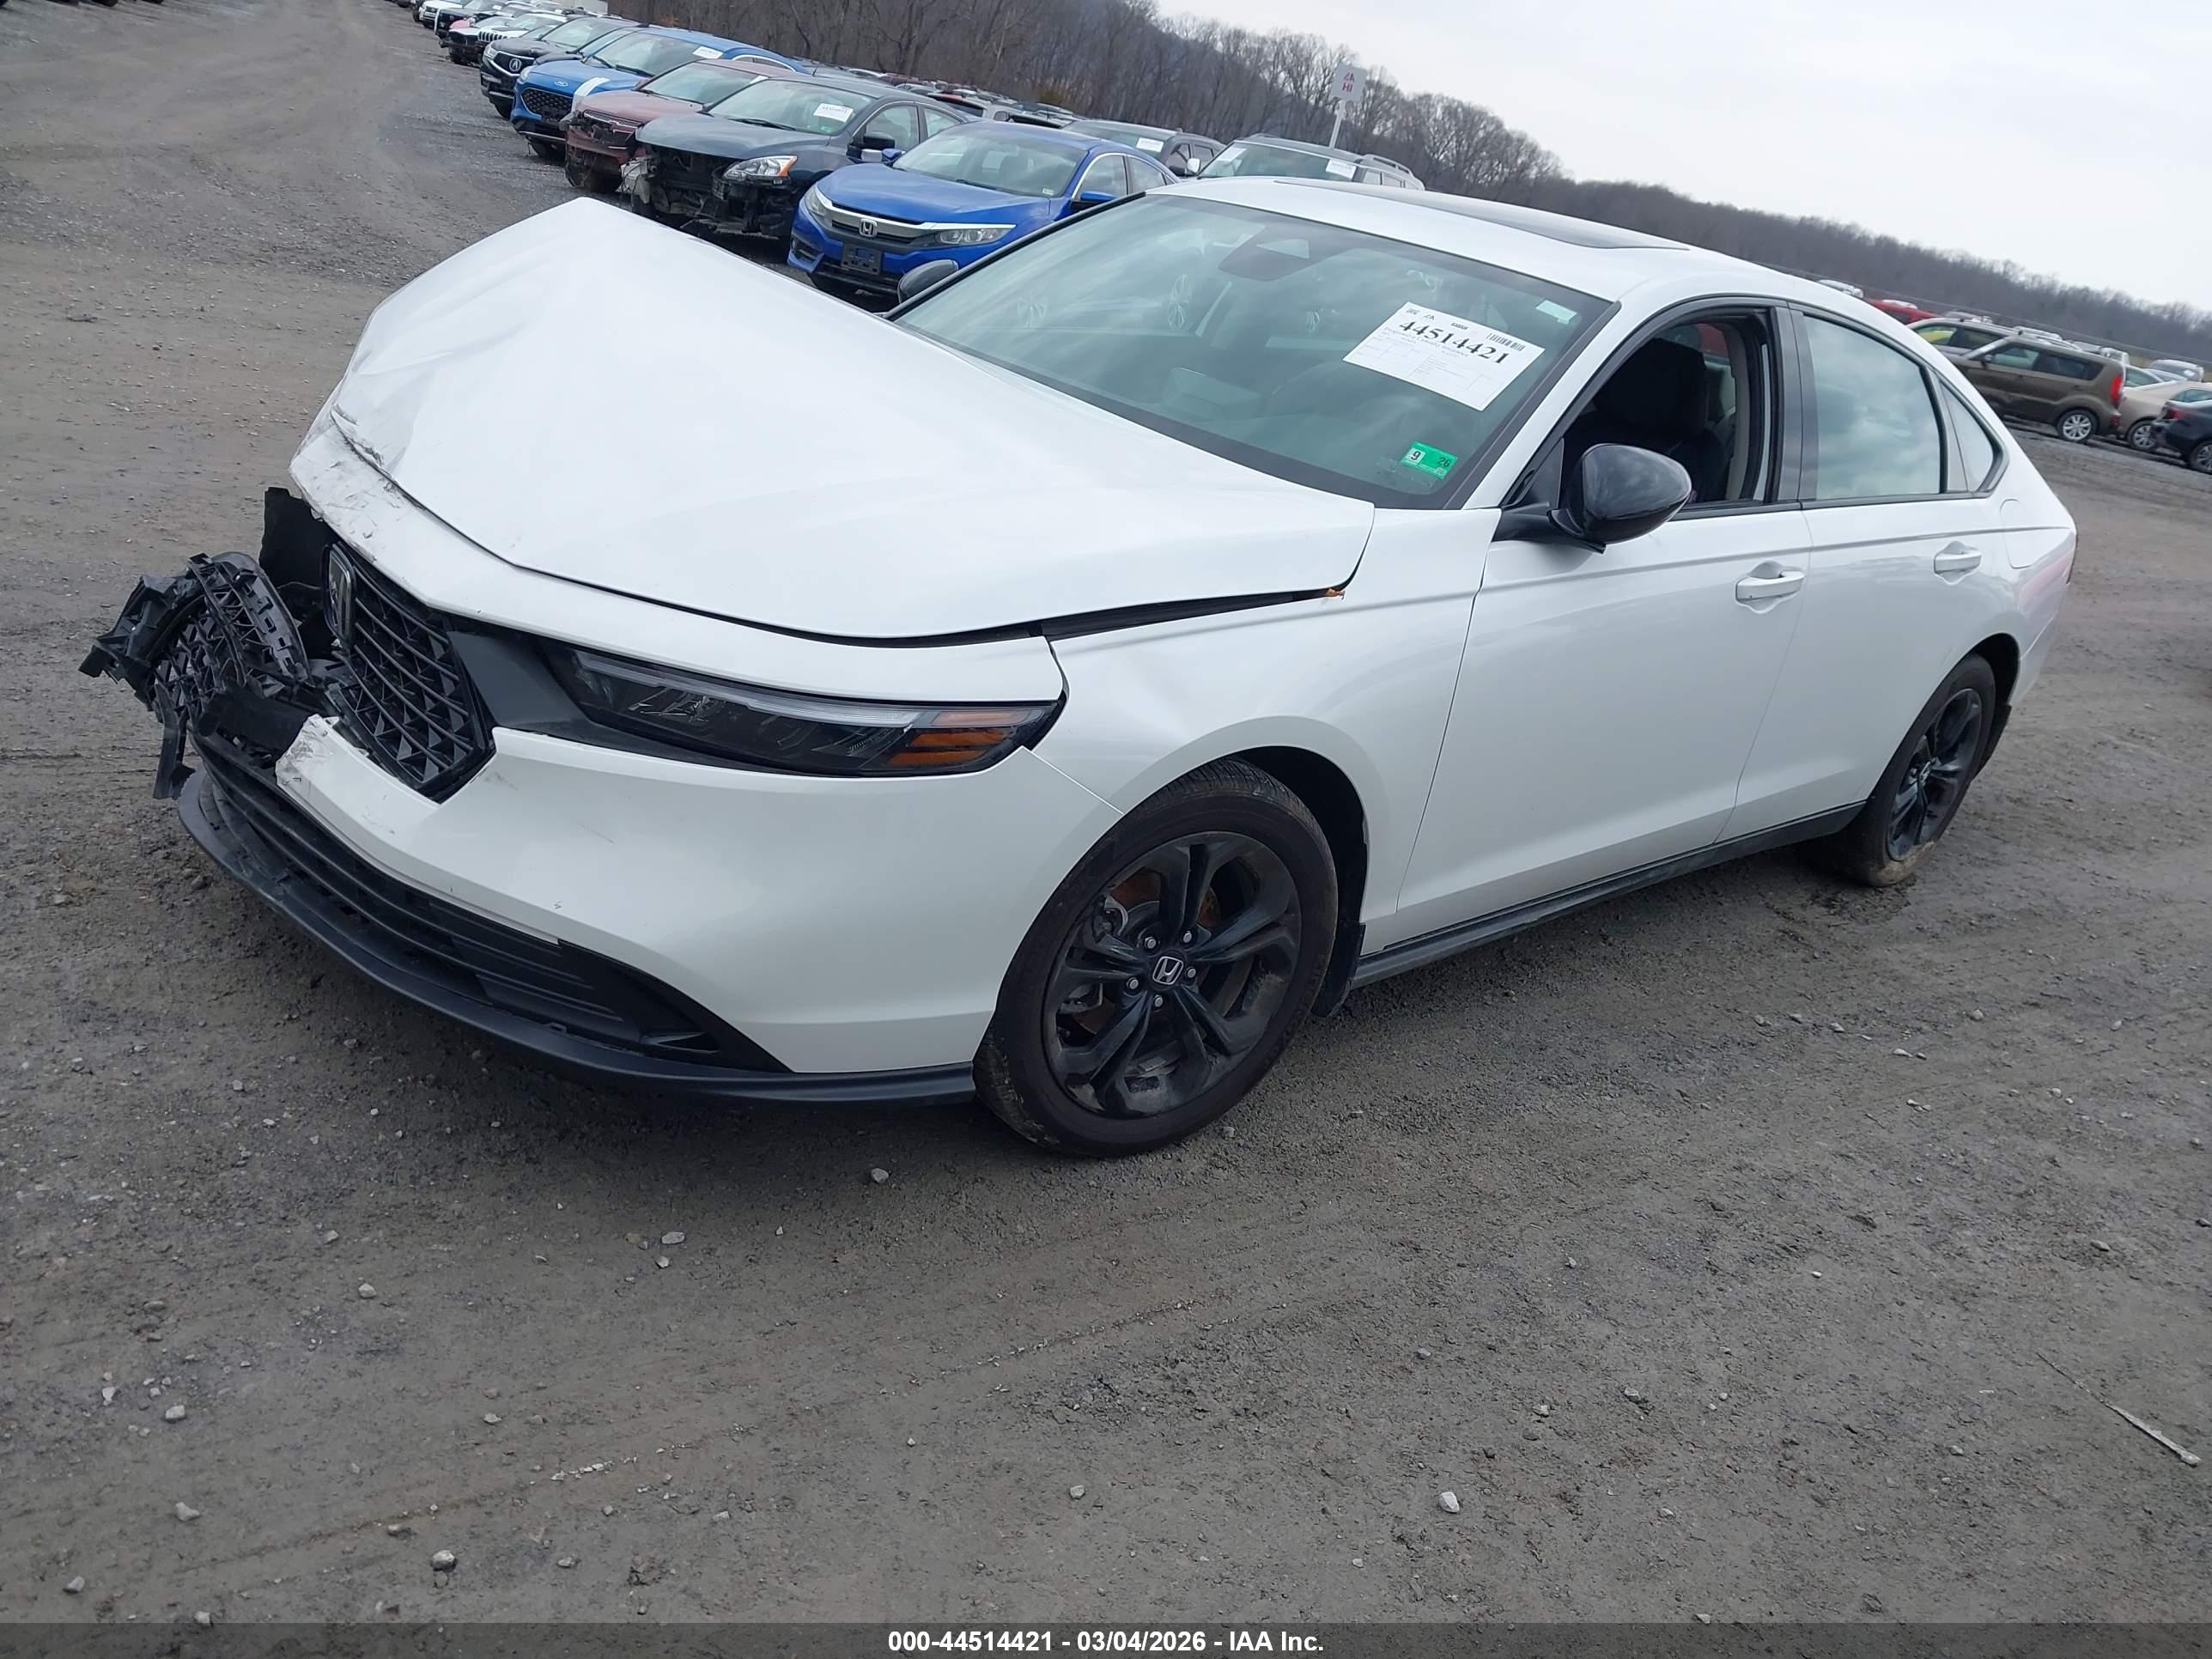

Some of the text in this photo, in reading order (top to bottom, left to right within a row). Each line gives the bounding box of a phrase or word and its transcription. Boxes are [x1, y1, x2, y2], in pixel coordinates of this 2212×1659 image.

[1399, 321, 1510, 364] 44514421
[1410, 451, 1421, 461] 9
[1437, 457, 1451, 467] 26
